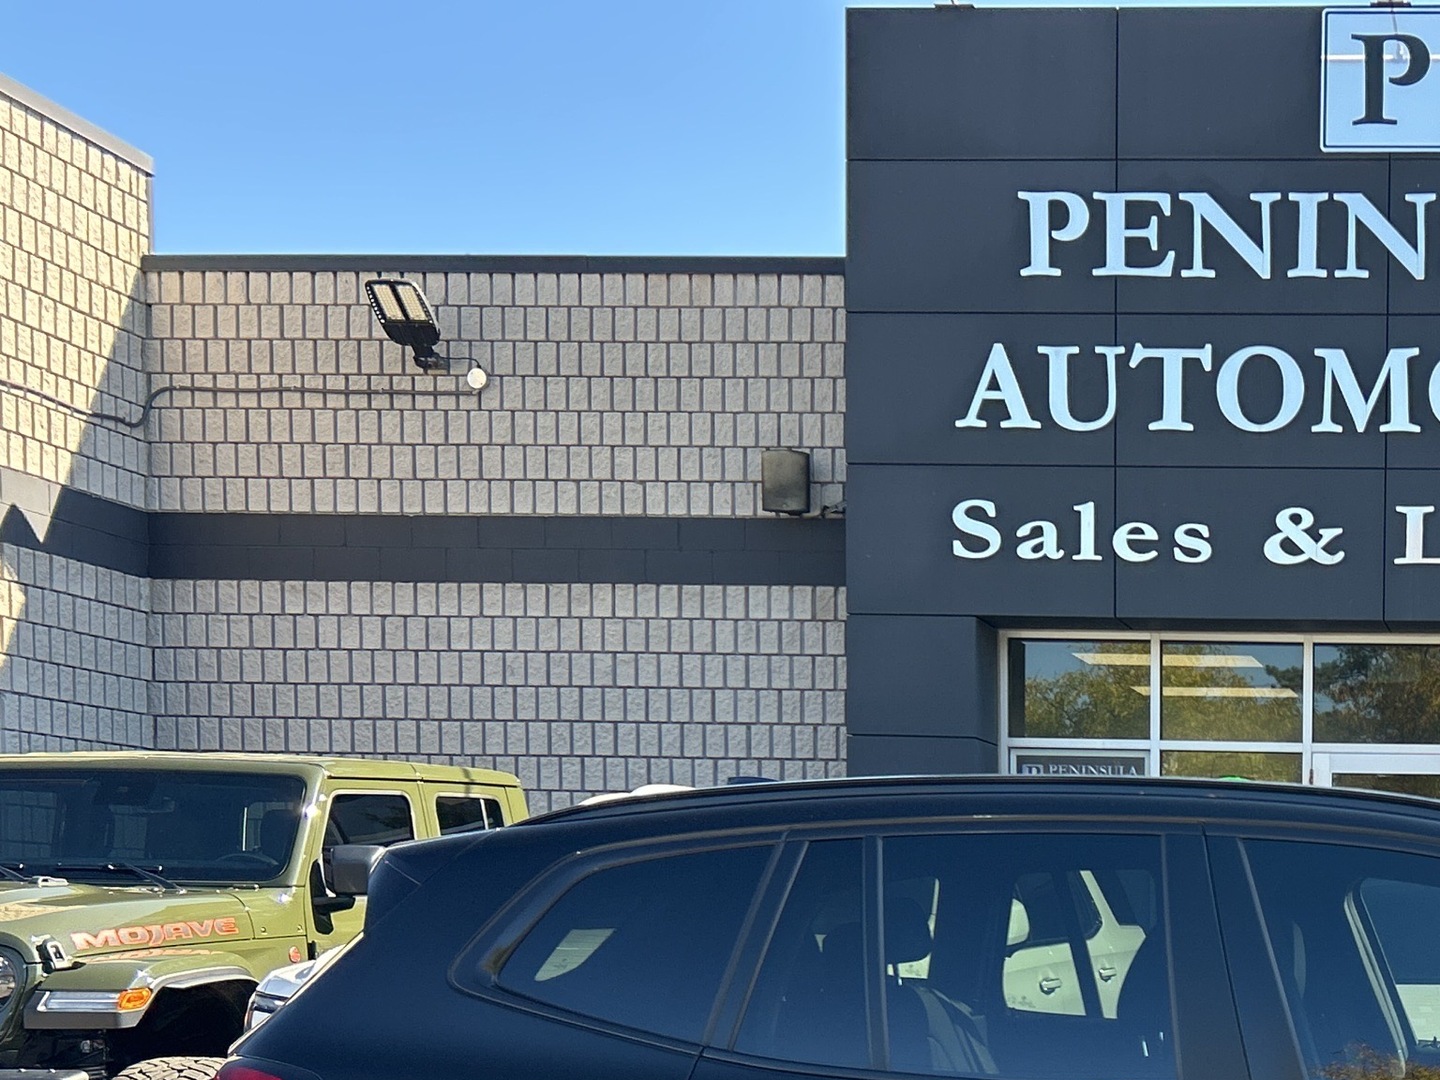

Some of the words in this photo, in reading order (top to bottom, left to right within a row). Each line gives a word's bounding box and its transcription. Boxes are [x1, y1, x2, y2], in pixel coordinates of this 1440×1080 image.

[1350, 33, 1430, 126] P
[952, 499, 1212, 564] Sales
[1263, 506, 1345, 565] &
[1049, 764, 1138, 776] PENINSULA
[70, 917, 239, 950] MOJAVE
